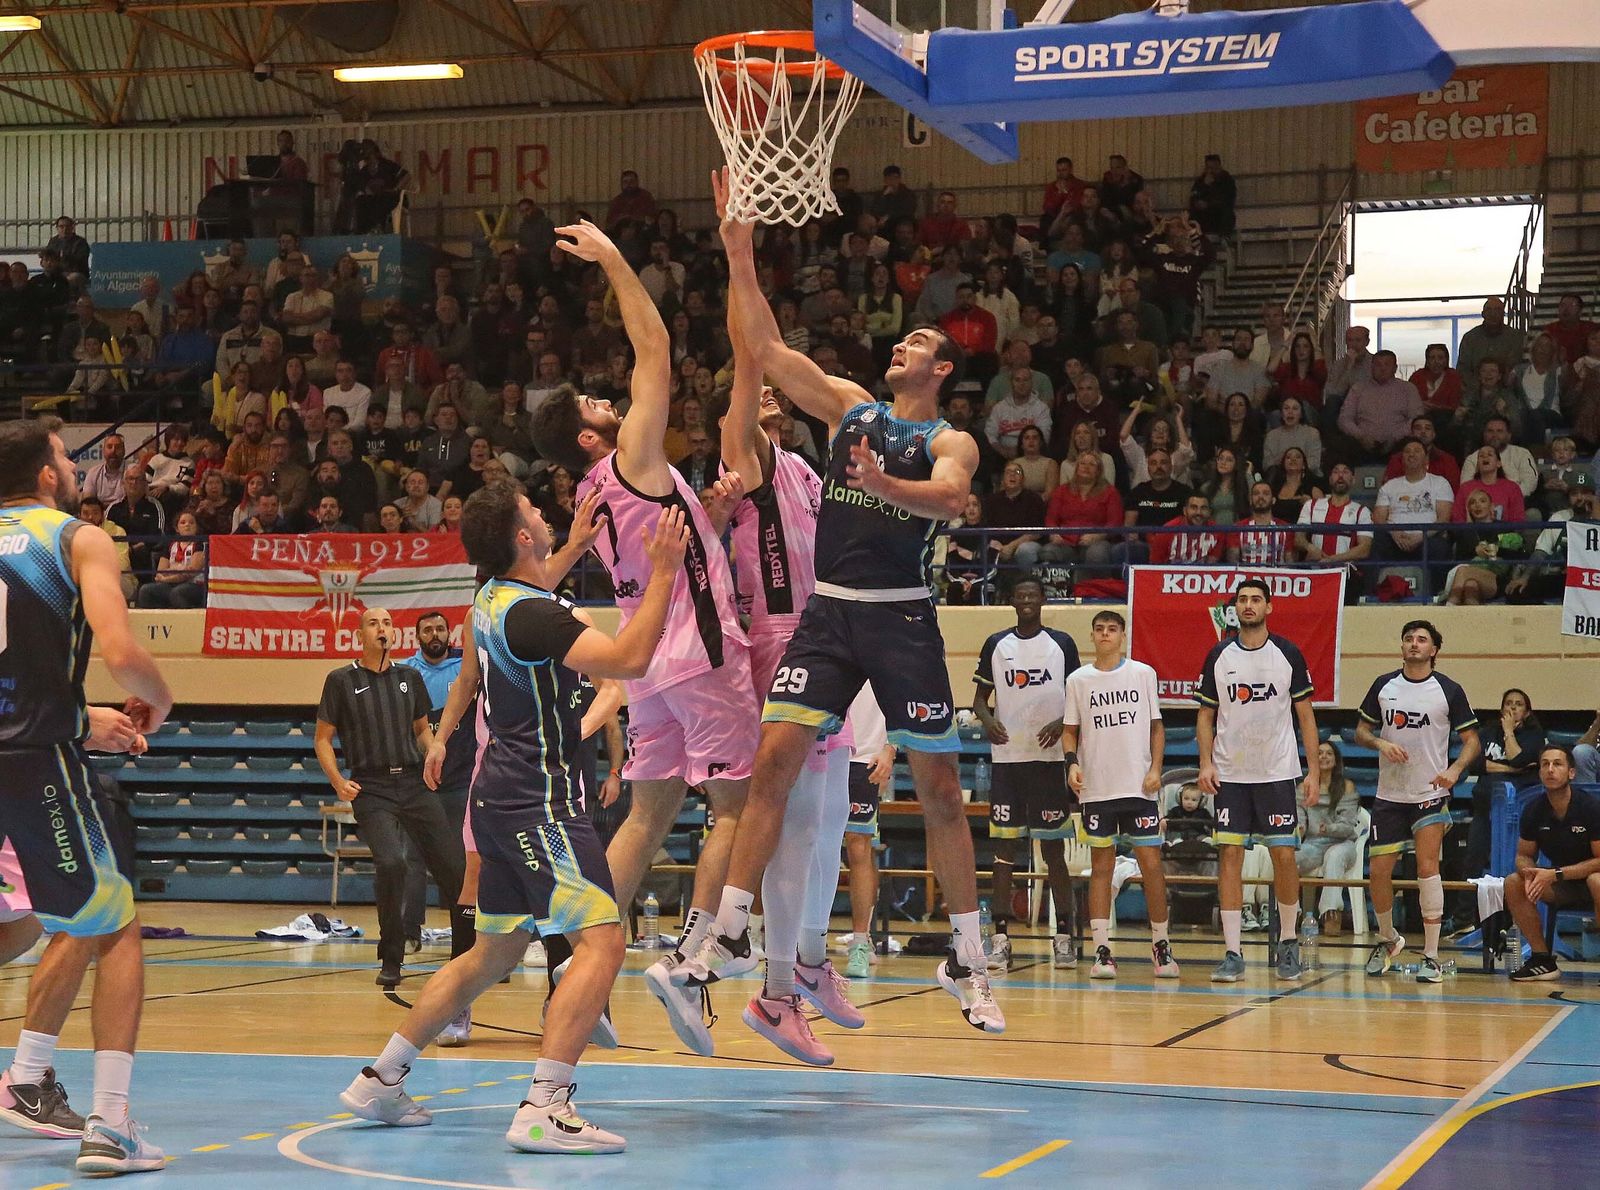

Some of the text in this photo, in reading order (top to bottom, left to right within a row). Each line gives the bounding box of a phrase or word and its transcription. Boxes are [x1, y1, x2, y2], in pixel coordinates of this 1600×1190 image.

[1015, 32, 1281, 74] SPORT SYSTEM
[1365, 103, 1538, 144] Cafetería
[251, 534, 431, 566] PEÑA 1912
[1585, 527, 1600, 552] A
[210, 626, 327, 652] SENTIRE
[771, 666, 810, 695] 29
[1004, 668, 1053, 690] UDEA
[1090, 690, 1139, 709] ÁNIMO
[1226, 682, 1278, 706] UDEA
[1093, 711, 1137, 730] RILEY
[992, 804, 1011, 823] 35
[1089, 813, 1100, 831] 5
[42, 784, 79, 873] damex.io
